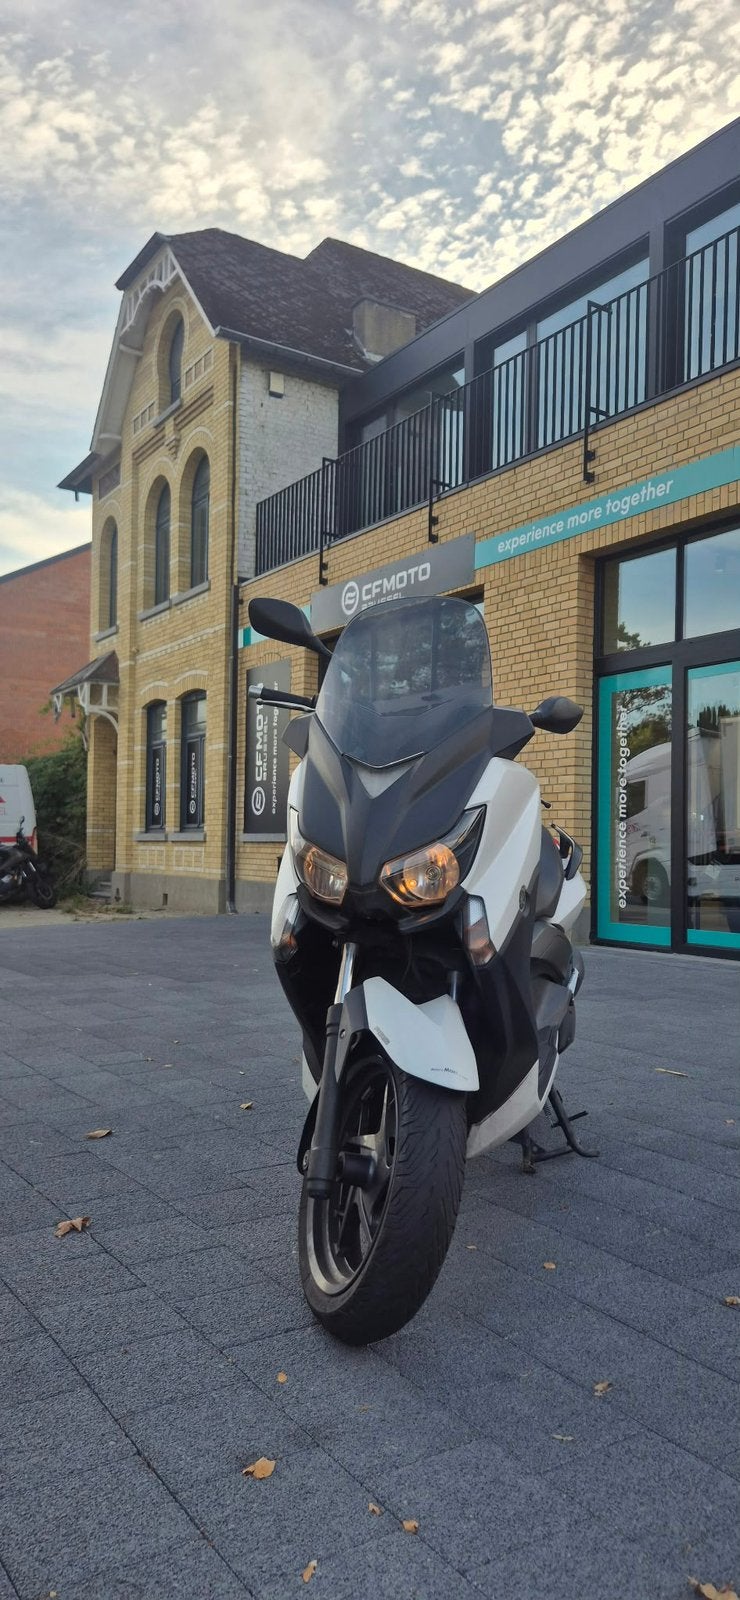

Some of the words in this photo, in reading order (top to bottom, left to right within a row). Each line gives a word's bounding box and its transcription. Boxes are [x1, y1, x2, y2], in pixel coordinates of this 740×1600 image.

[497, 520, 564, 554] experience
[567, 506, 602, 529] more
[606, 480, 674, 516] together
[362, 562, 431, 600] CFMOTO
[256, 683, 264, 781] CFMOT
[617, 705, 630, 773] together
[619, 778, 627, 818] more
[616, 821, 629, 908] experience
